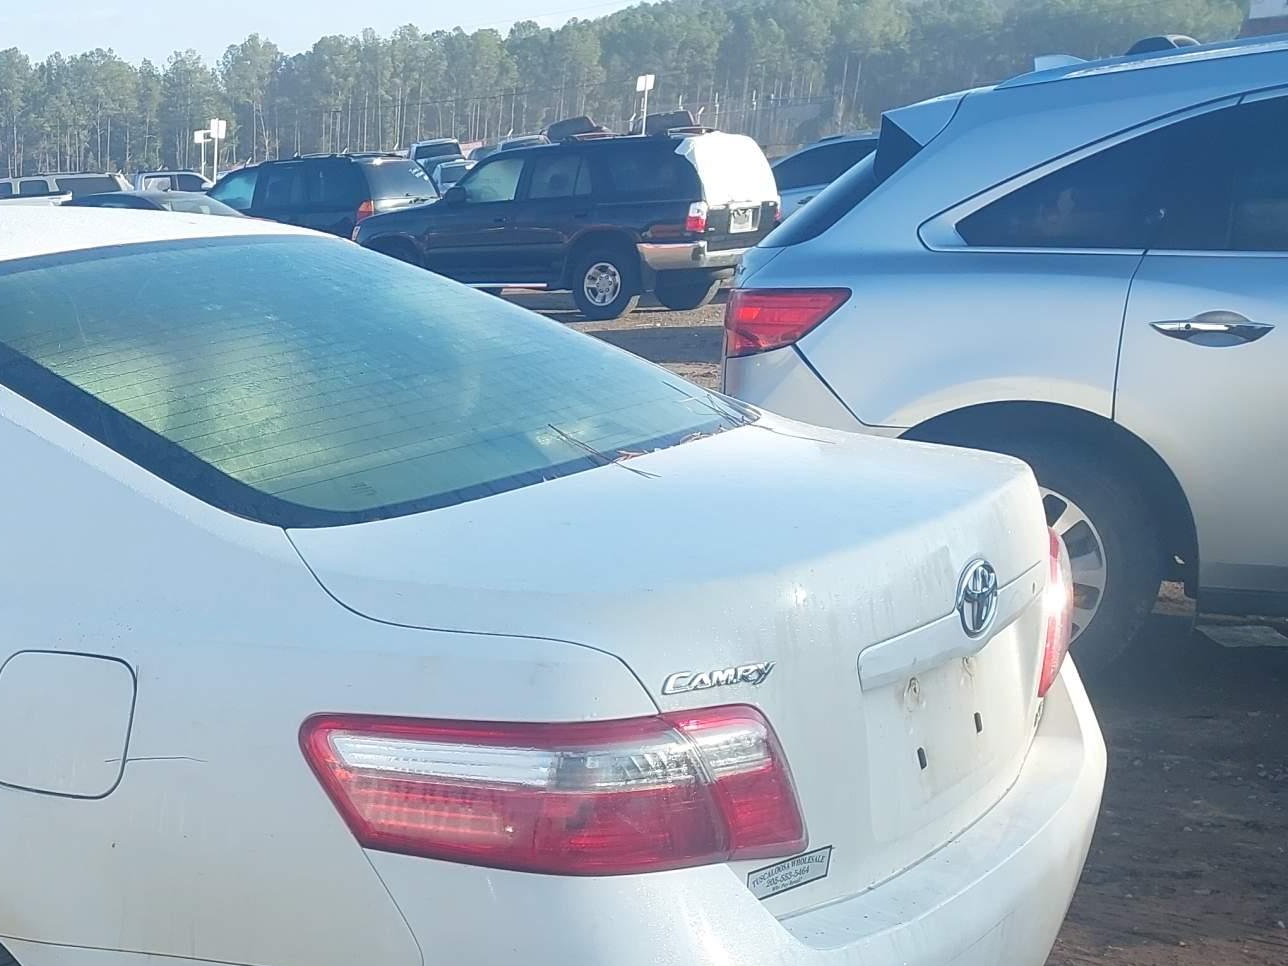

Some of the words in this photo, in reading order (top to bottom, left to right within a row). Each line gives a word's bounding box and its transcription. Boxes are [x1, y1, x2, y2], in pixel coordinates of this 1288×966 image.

[661, 661, 776, 695] CAMRY
[752, 863, 790, 888] TUSCALOOSA
[792, 855, 826, 868] WHOLESALE
